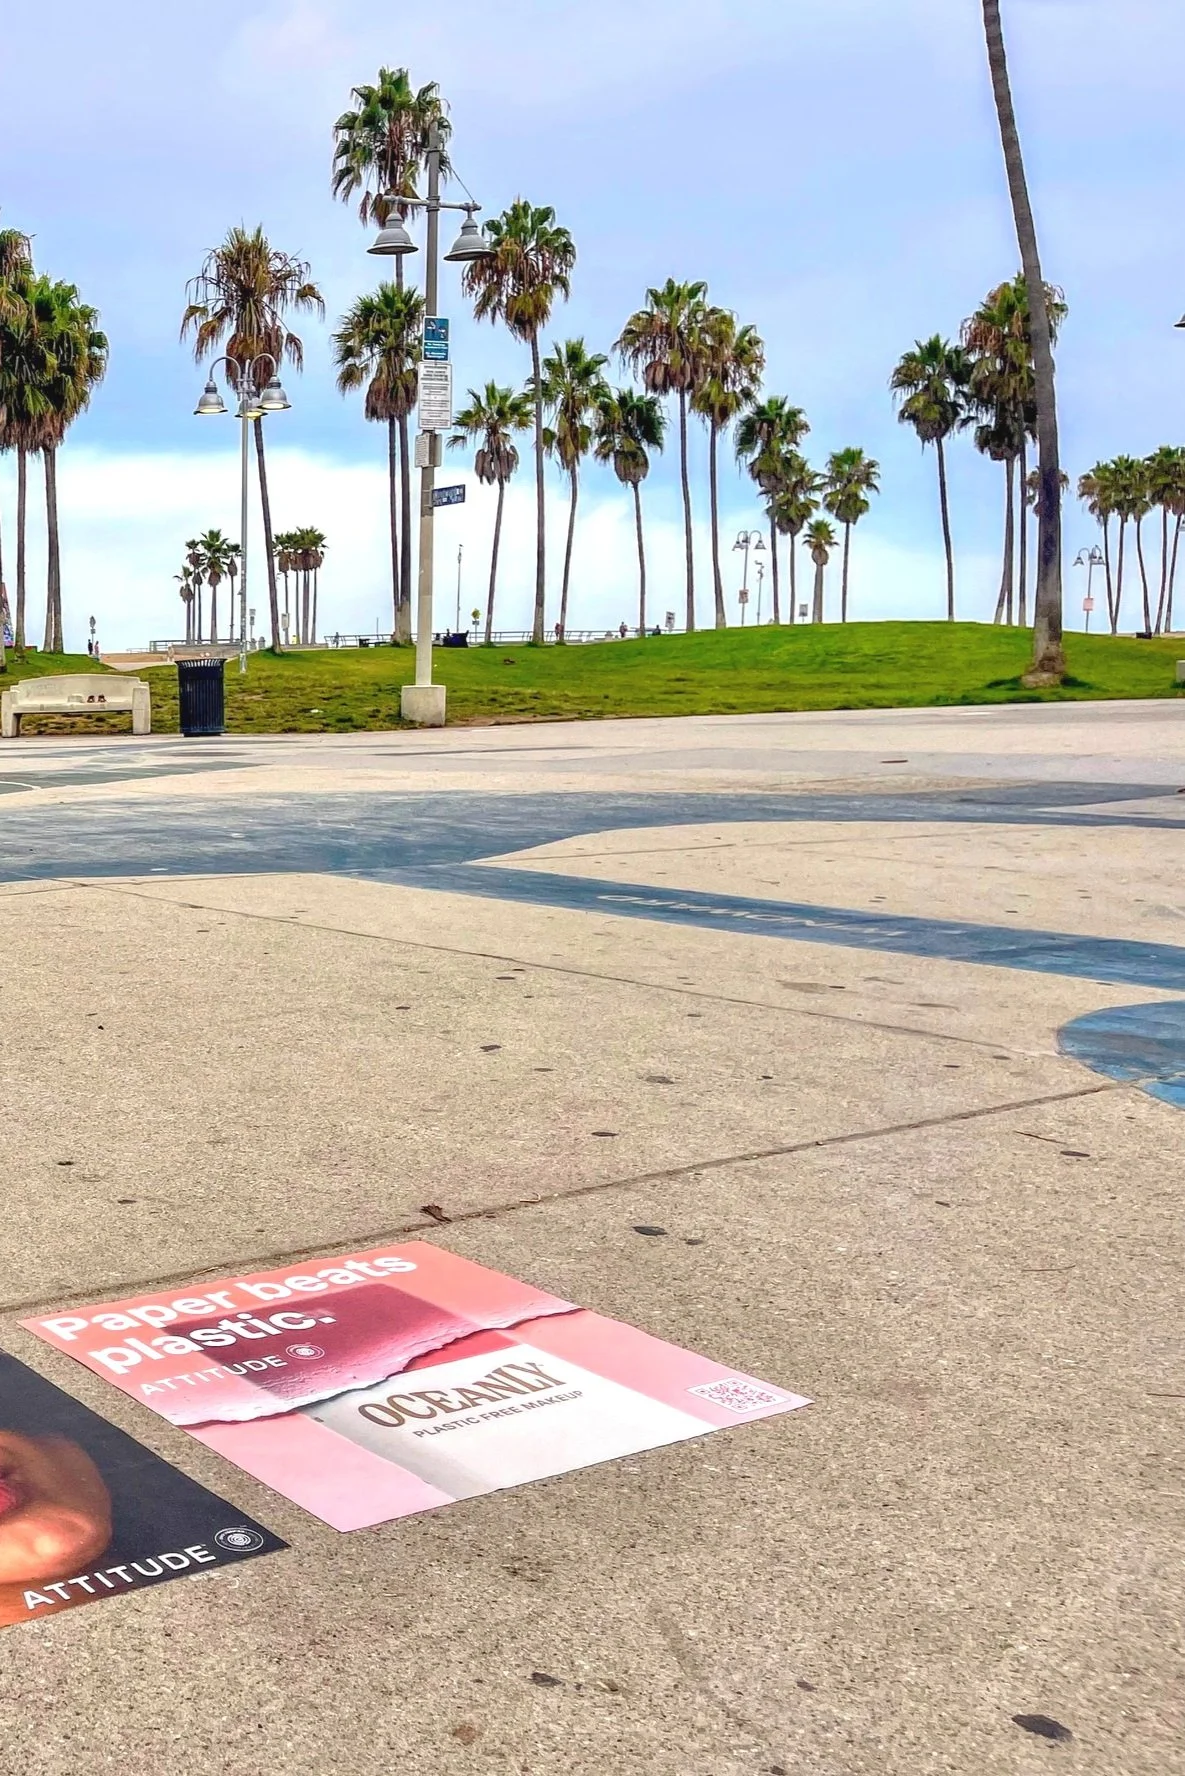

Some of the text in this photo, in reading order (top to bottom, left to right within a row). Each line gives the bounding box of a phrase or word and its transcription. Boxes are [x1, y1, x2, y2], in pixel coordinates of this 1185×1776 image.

[40, 1255, 418, 1342] Paper beats
[87, 1311, 337, 1375] plastic.
[139, 1354, 288, 1396] ATTITUDE
[358, 1361, 567, 1428] OCEANLY
[412, 1390, 584, 1438] PLASTIC FREE MAKEUP
[22, 1544, 216, 1610] ATTITUDE
